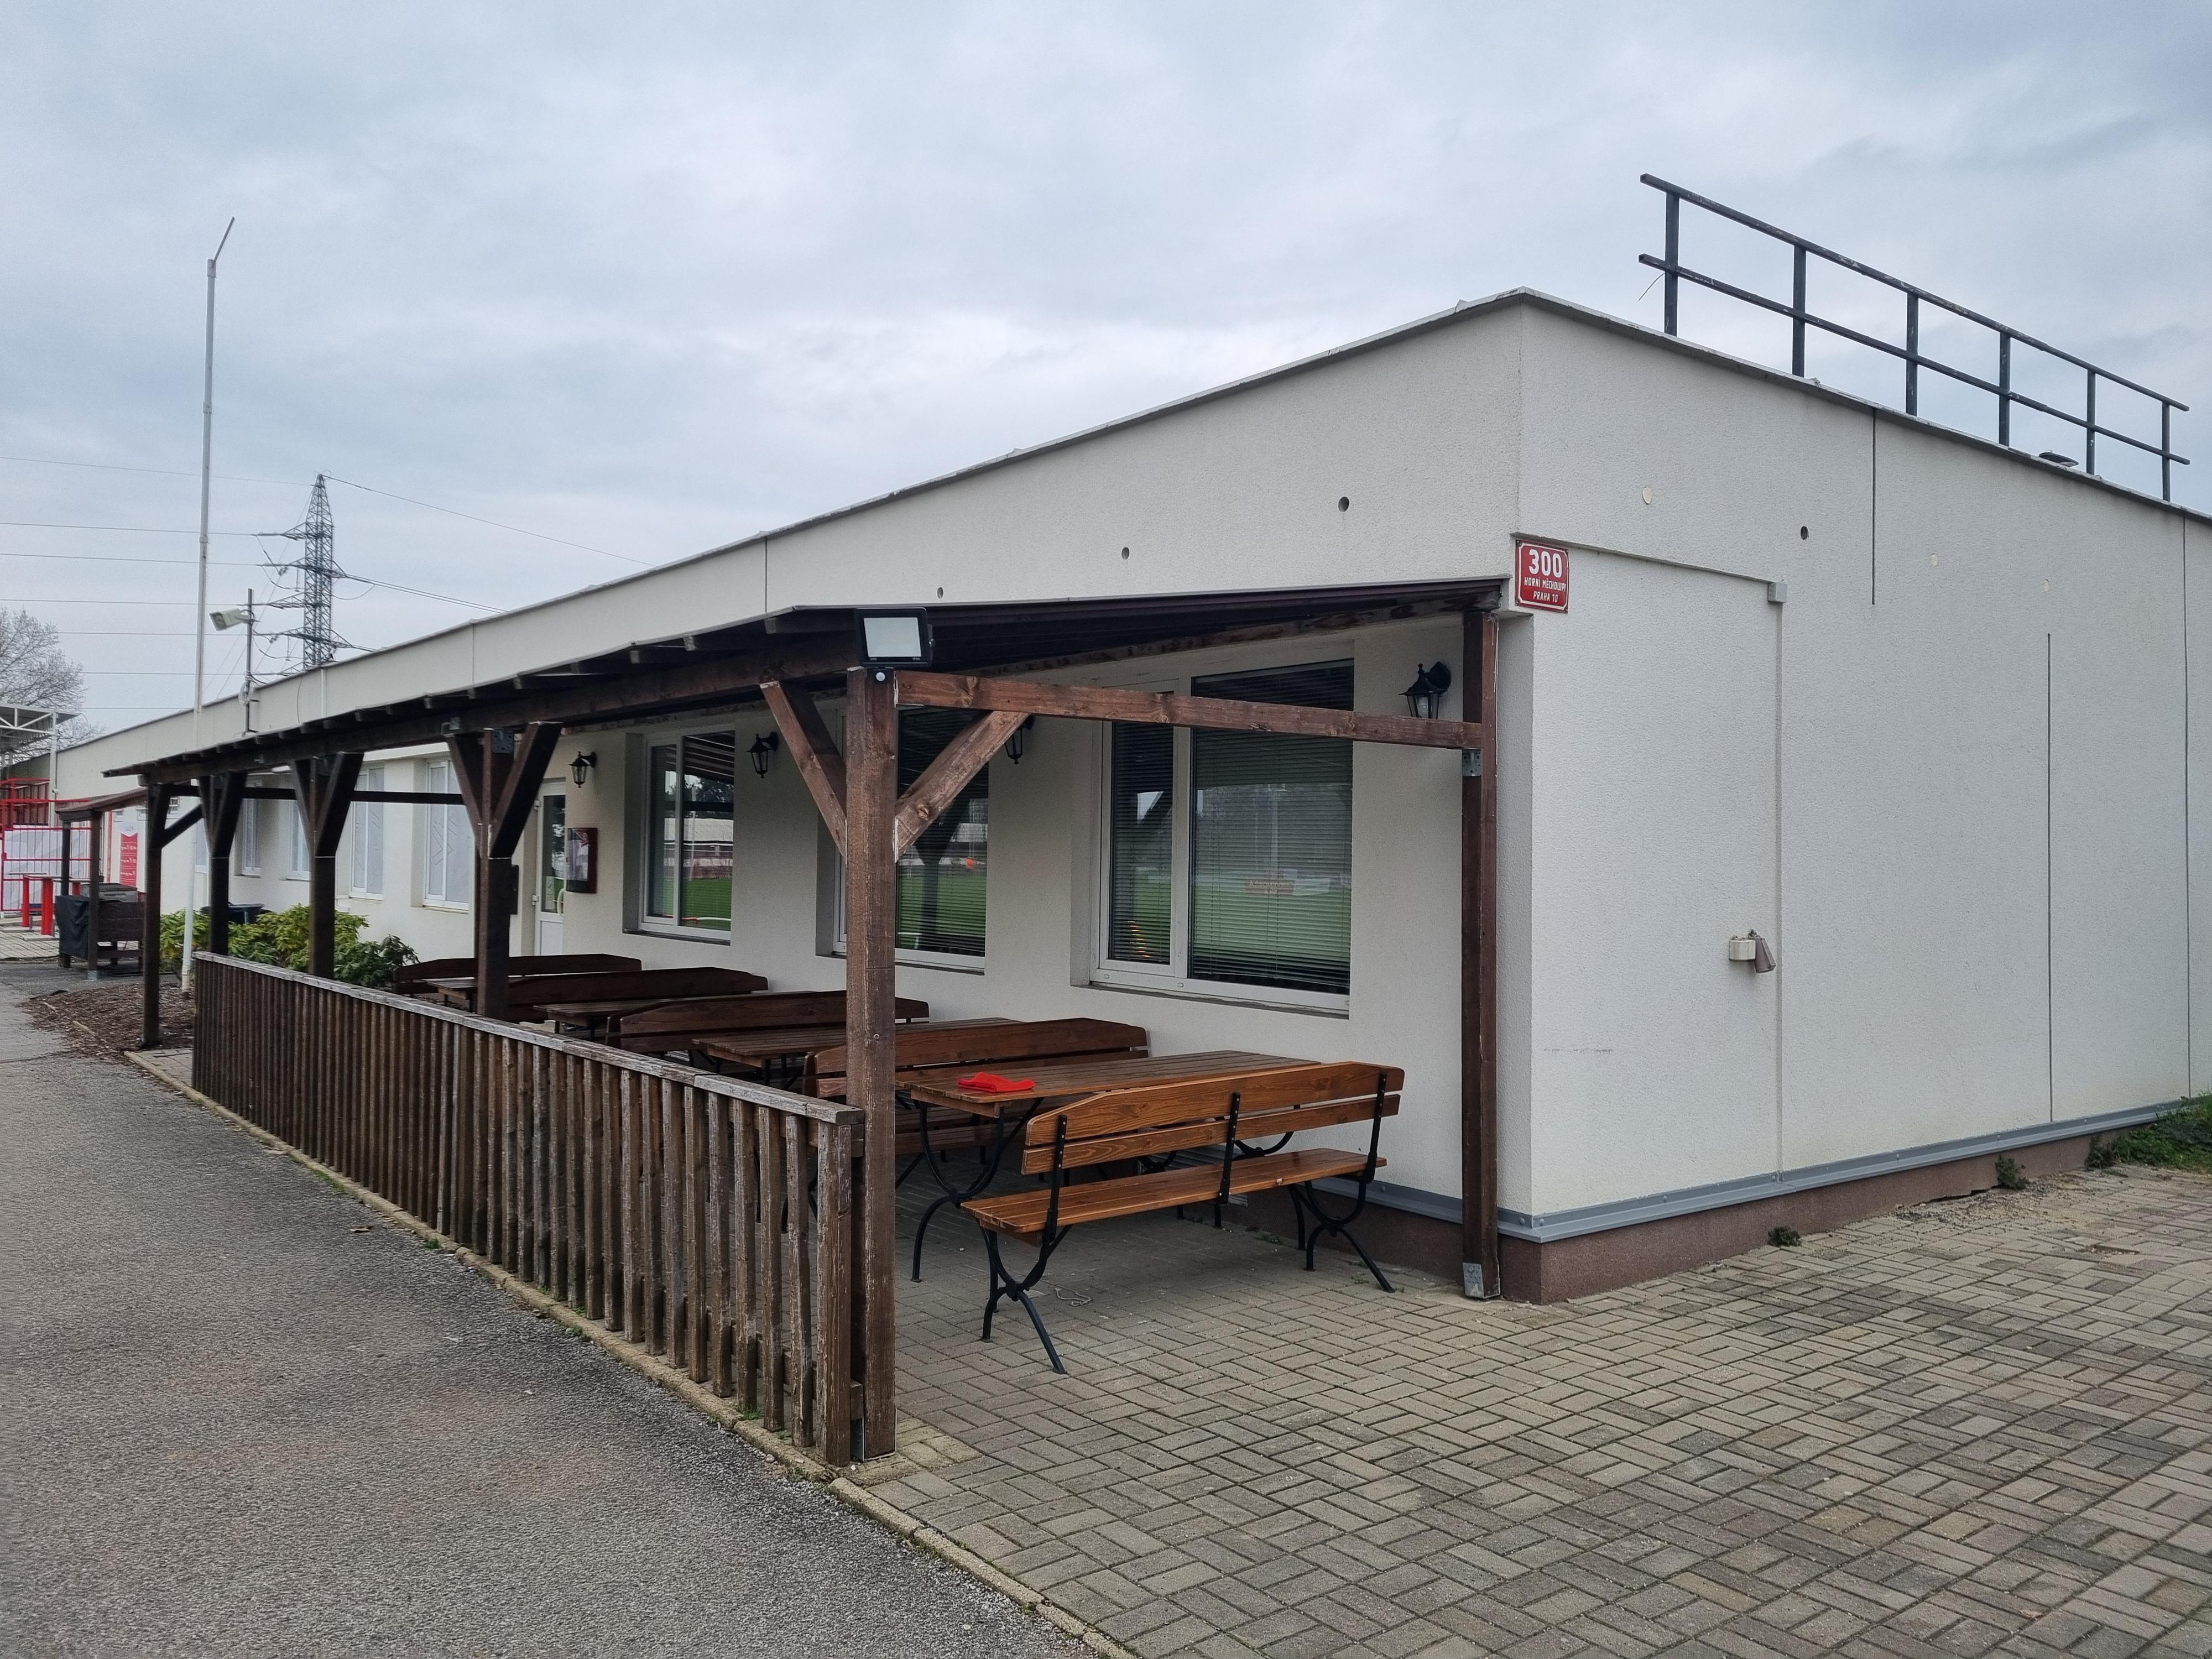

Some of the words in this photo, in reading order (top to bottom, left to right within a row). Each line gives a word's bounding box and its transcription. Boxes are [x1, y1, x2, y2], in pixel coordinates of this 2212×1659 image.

[1529, 549, 1562, 578] 300
[1524, 577, 1541, 587] HORNÍ
[1533, 591, 1550, 602] PRAHA
[1552, 594, 1558, 603] 10
